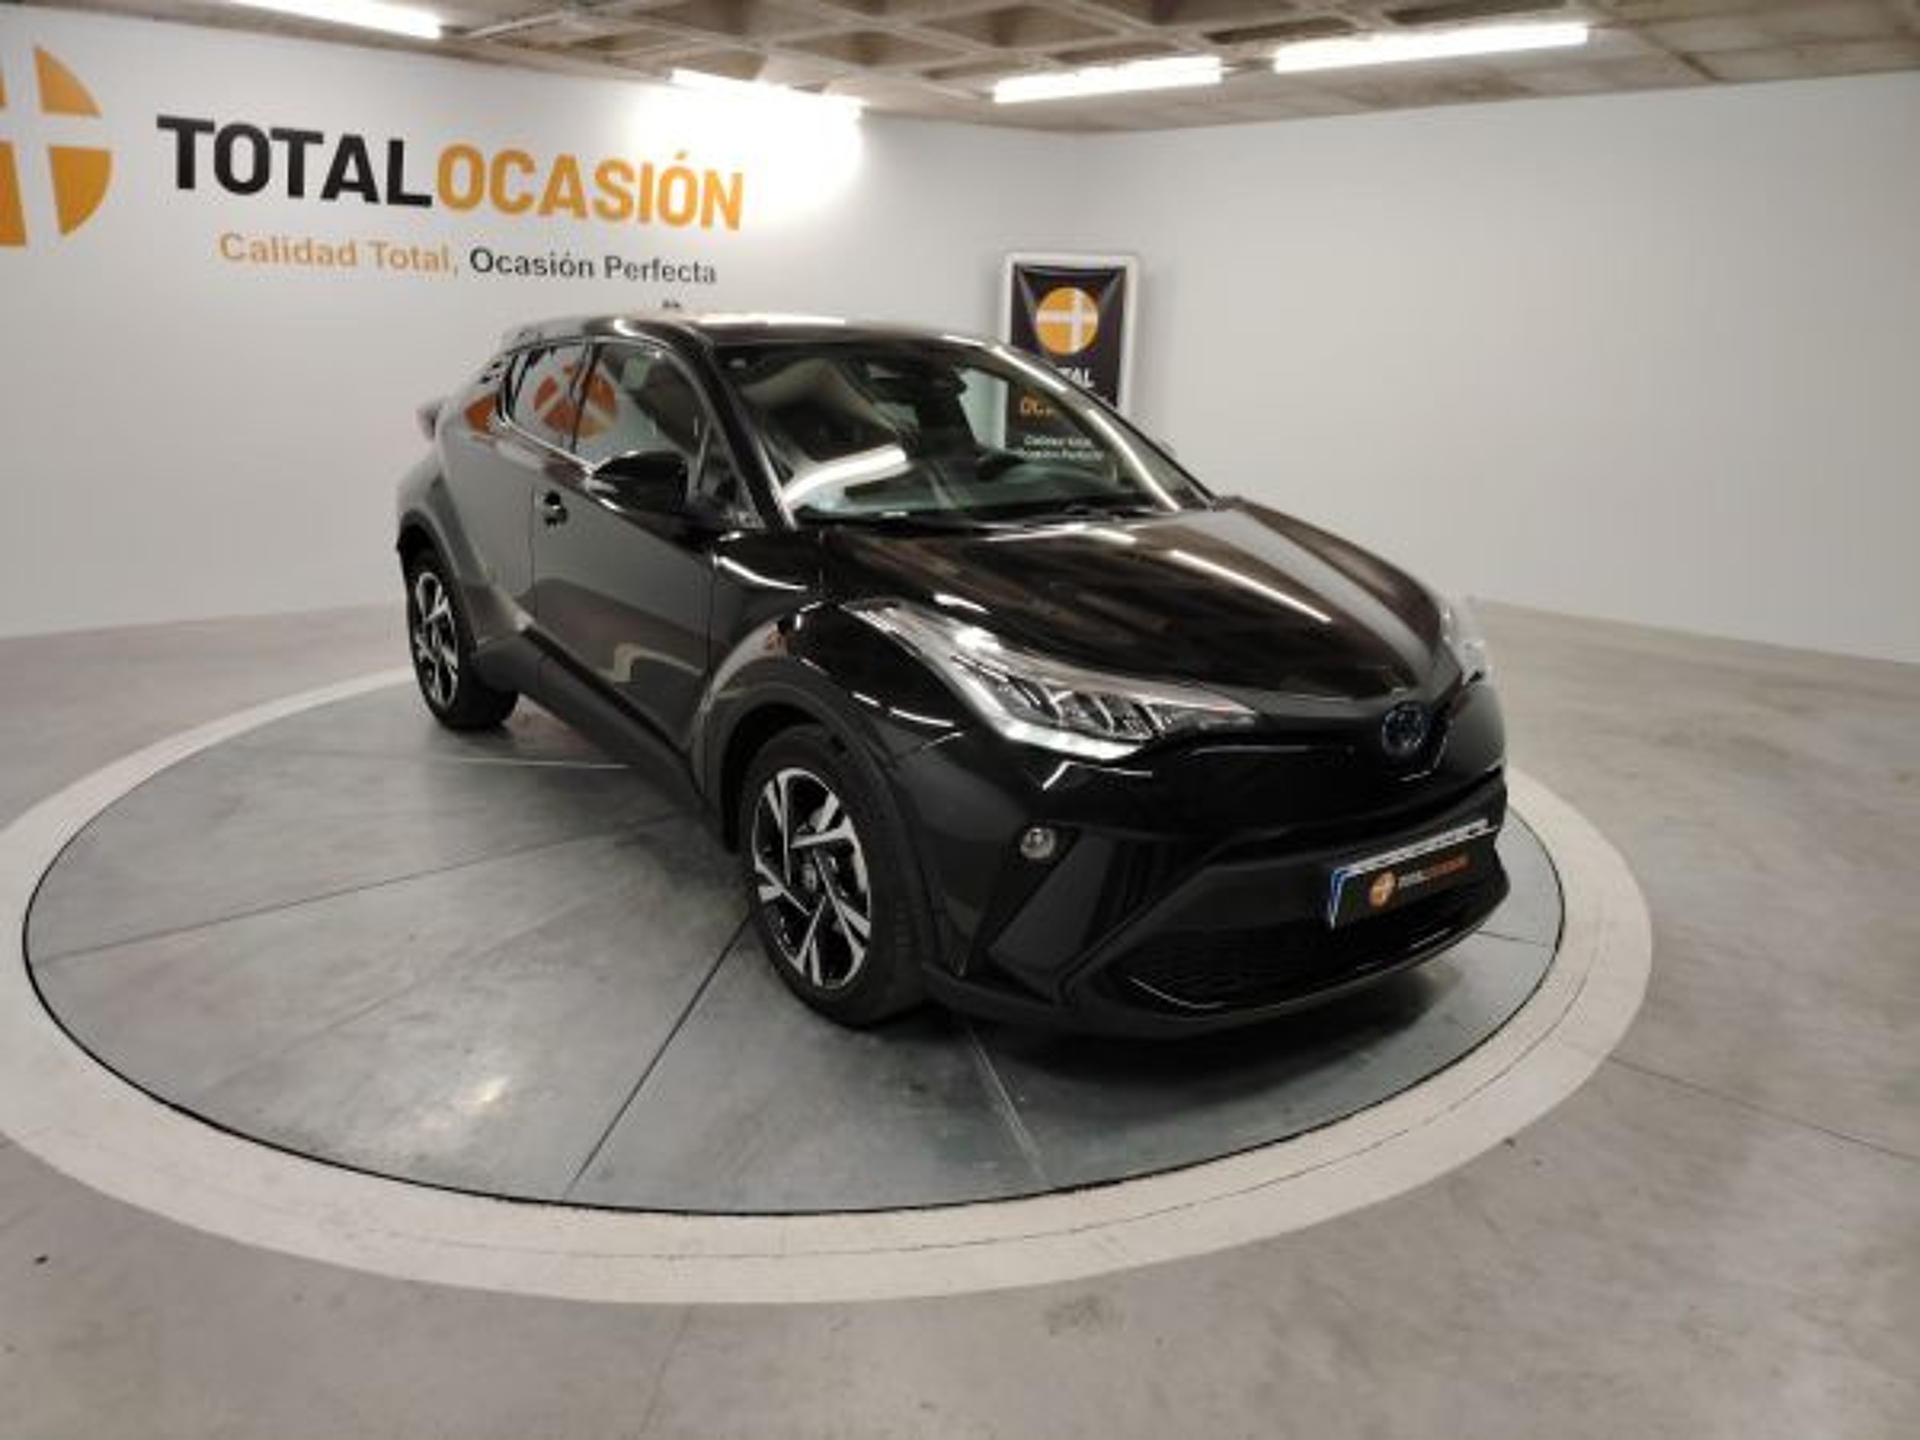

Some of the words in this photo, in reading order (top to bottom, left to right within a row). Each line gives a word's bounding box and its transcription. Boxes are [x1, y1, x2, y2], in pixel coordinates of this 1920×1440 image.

[219, 232, 357, 267] Calidad
[369, 239, 458, 276] Total,
[469, 246, 595, 279] Ocasión
[604, 254, 718, 284] Perfecta
